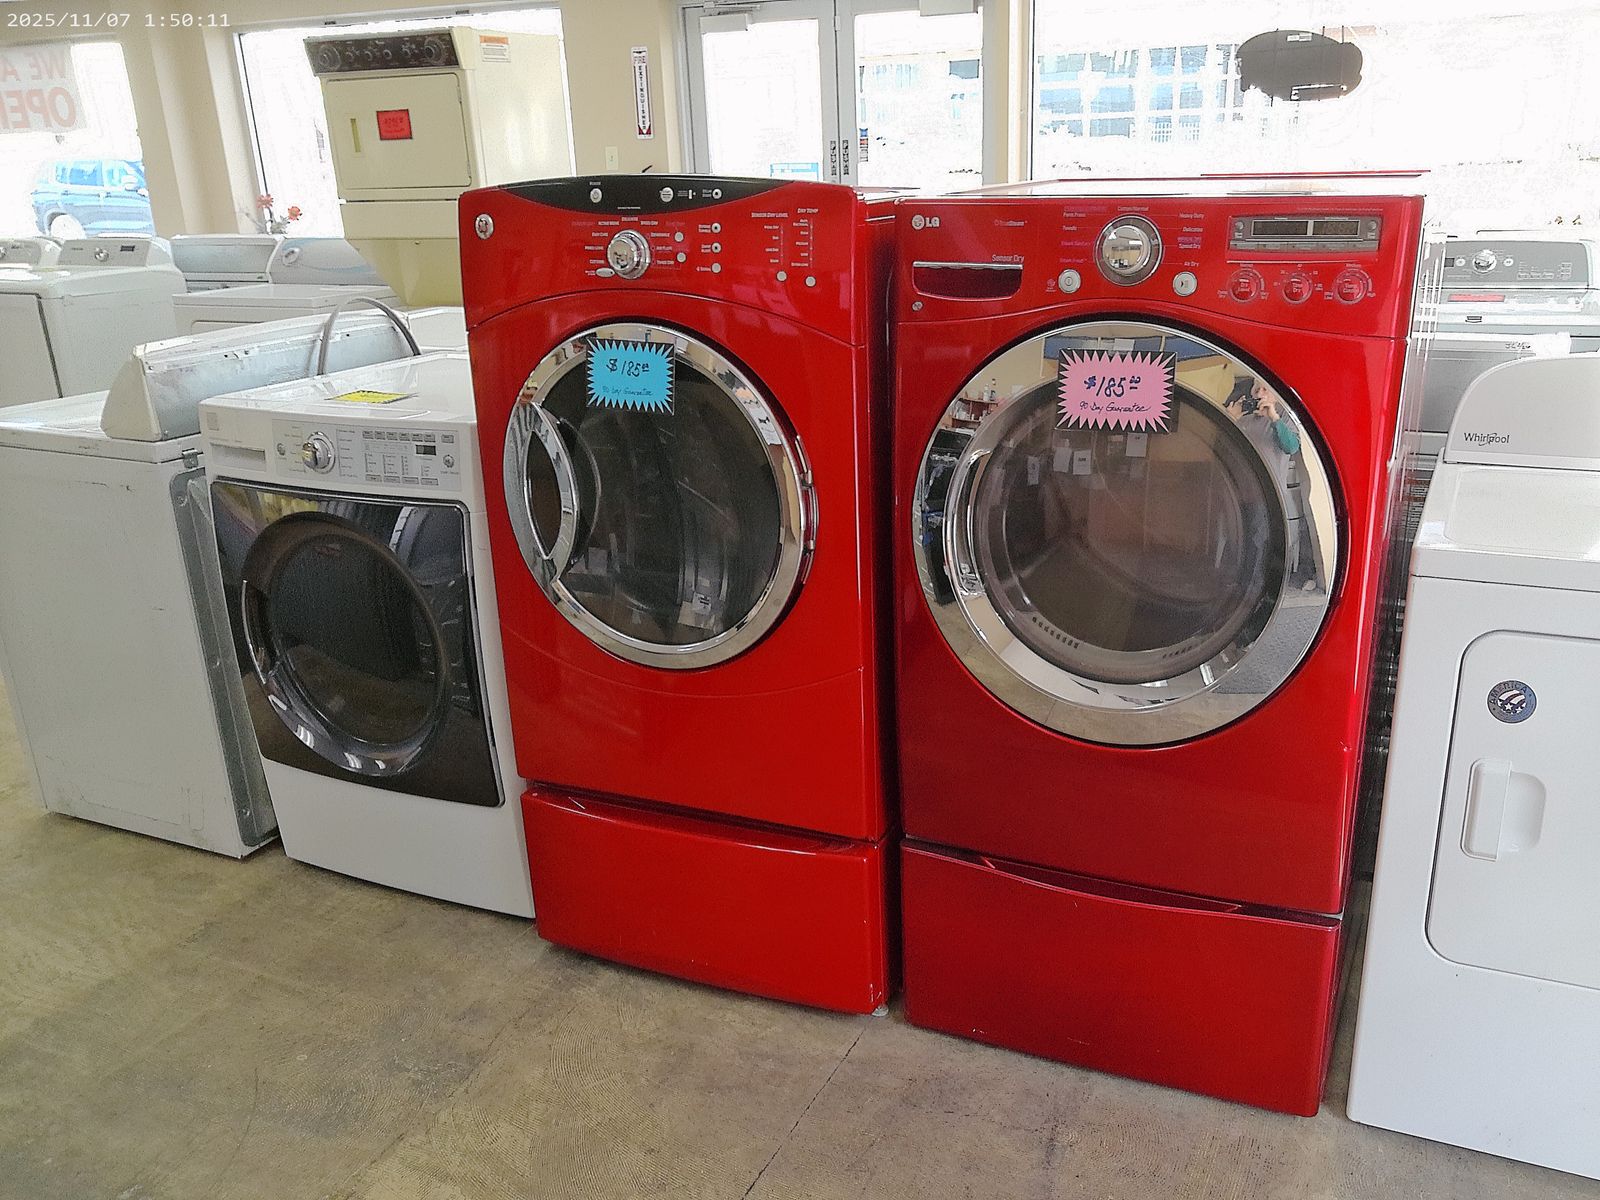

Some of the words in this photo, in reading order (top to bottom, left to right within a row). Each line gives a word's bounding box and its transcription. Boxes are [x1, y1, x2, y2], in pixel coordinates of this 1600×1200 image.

[925, 216, 940, 228] LG
[992, 254, 1012, 262] Sensor
[1013, 254, 1025, 263] Dry
[1463, 432, 1511, 446] Whirlpool
[1489, 682, 1527, 704] AMERICA
